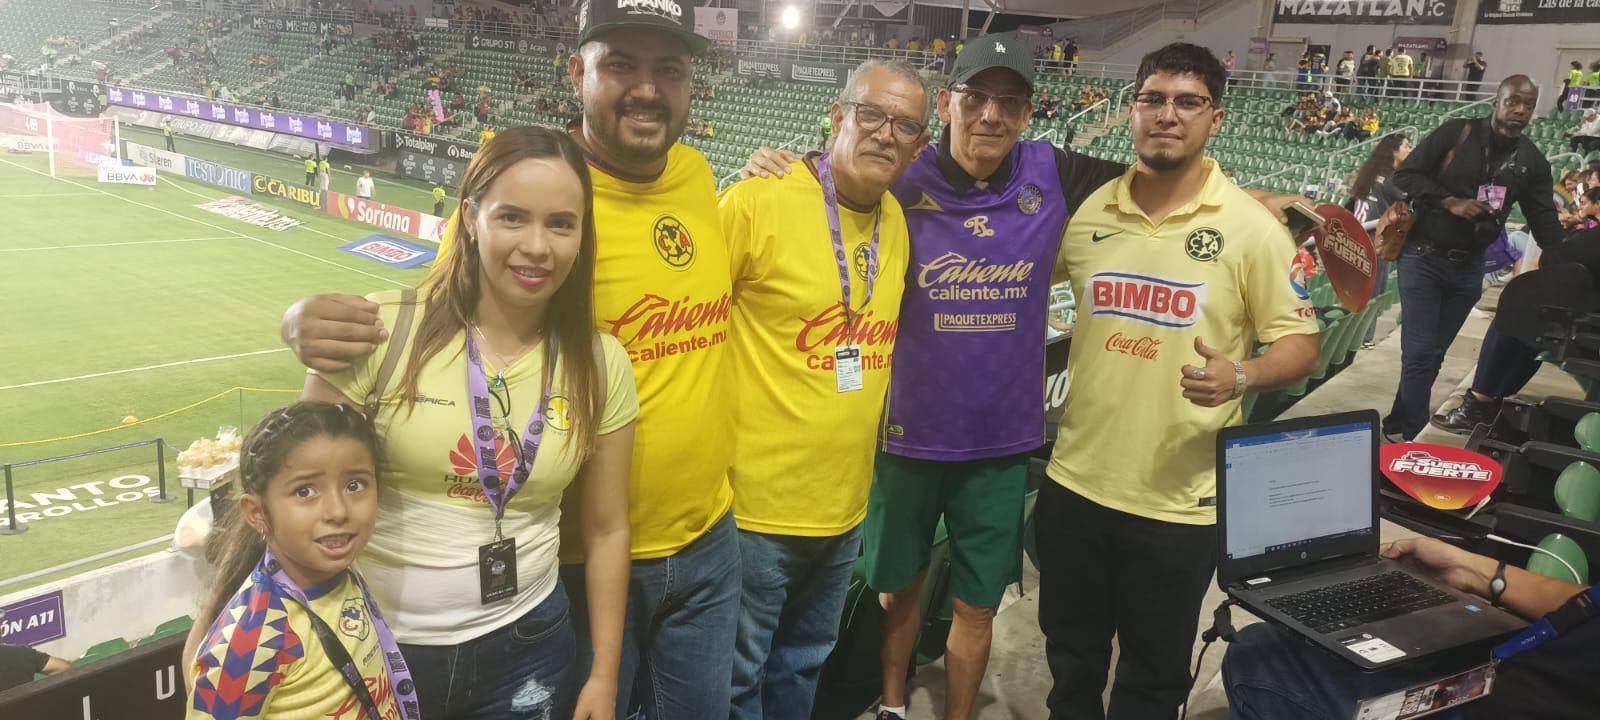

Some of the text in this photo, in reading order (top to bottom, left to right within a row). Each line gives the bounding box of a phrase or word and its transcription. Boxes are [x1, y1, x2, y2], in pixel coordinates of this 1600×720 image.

[404, 135, 435, 155] Totalplay
[356, 200, 411, 234] Soriana
[917, 251, 1035, 289] Caliente
[928, 285, 1028, 301] caliente.mx
[1092, 280, 1197, 319] BIMBO
[943, 312, 1017, 326] PAQUETEXPRESS
[1105, 331, 1164, 361] Coca-Cola
[1393, 459, 1490, 480] FUERTE
[1417, 458, 1478, 471] SUENA
[26, 609, 55, 630] A11
